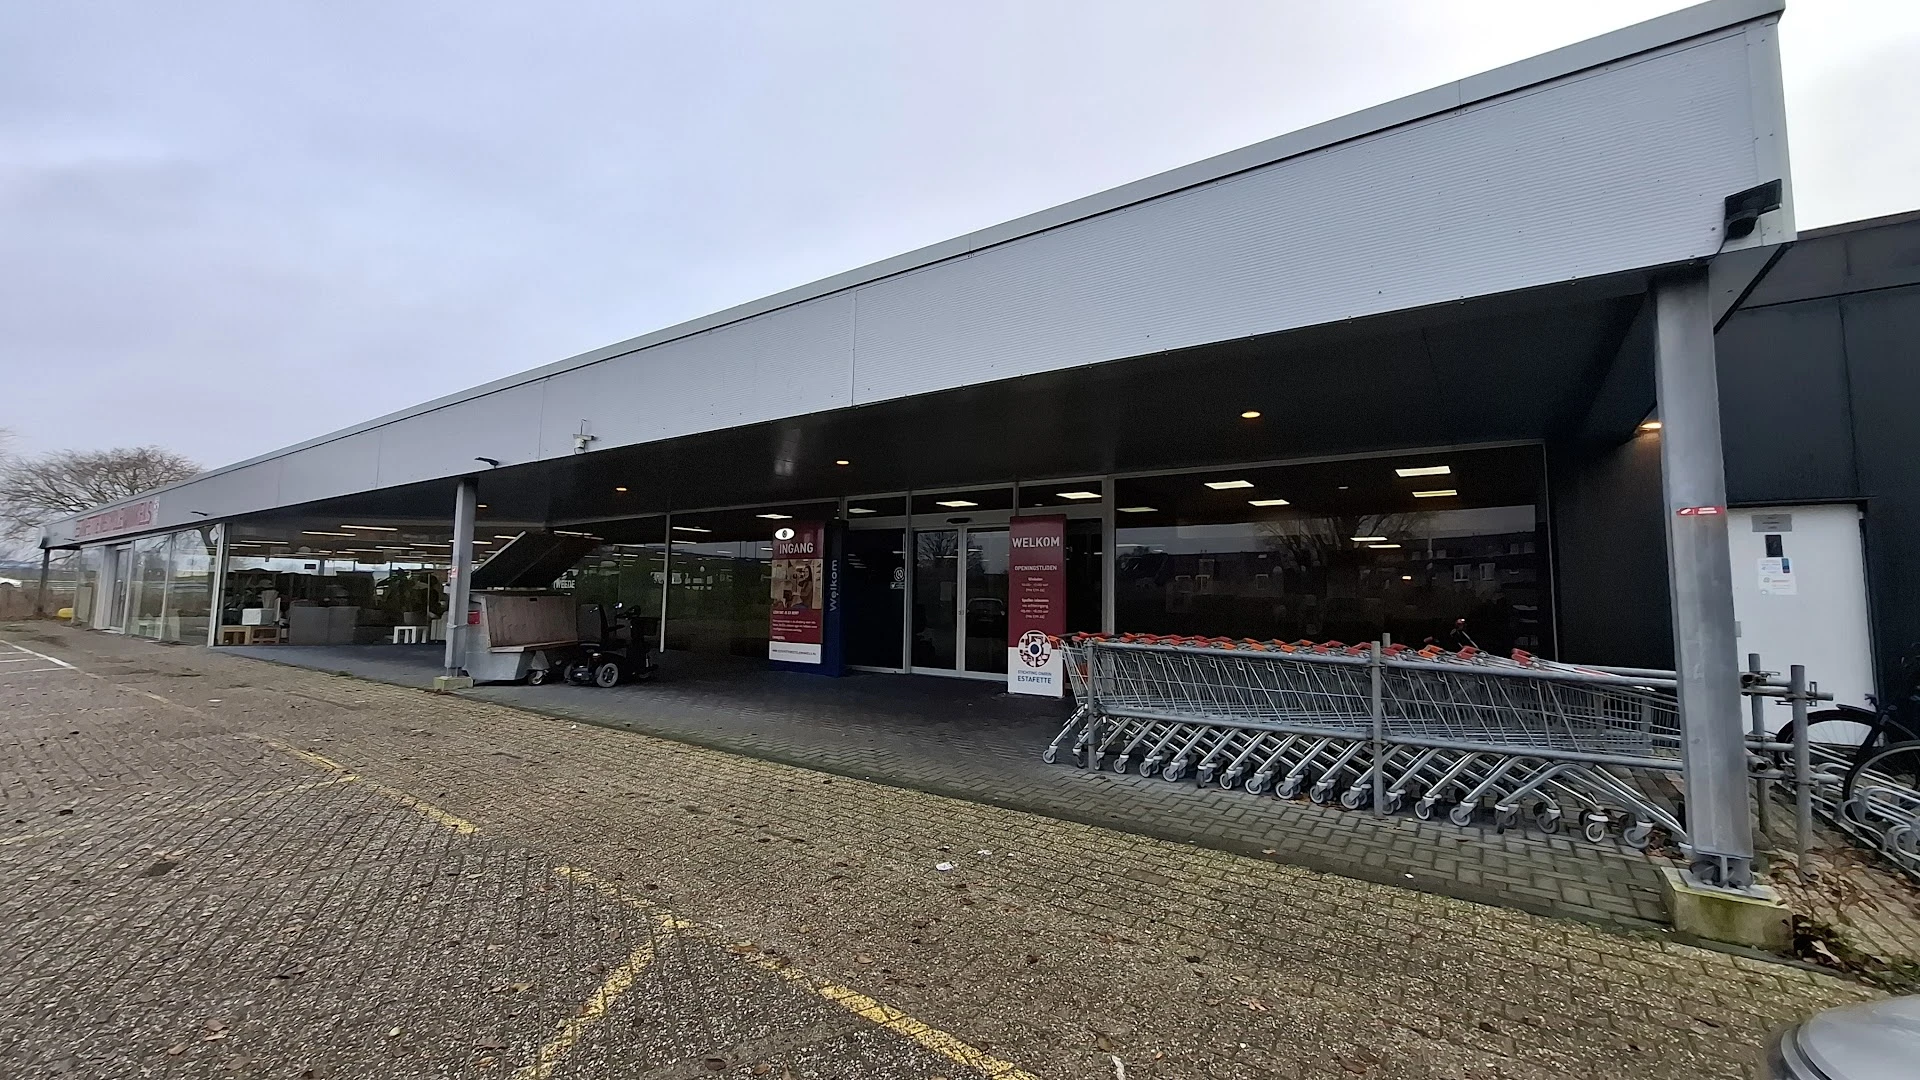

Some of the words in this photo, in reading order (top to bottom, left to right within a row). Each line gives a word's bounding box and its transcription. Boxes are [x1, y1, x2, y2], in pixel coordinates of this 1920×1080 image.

[1012, 536, 1060, 548] WELKOM
[779, 542, 814, 555] INGANG
[829, 559, 838, 612] Welkom
[1017, 675, 1052, 684] ESTAFETTE
